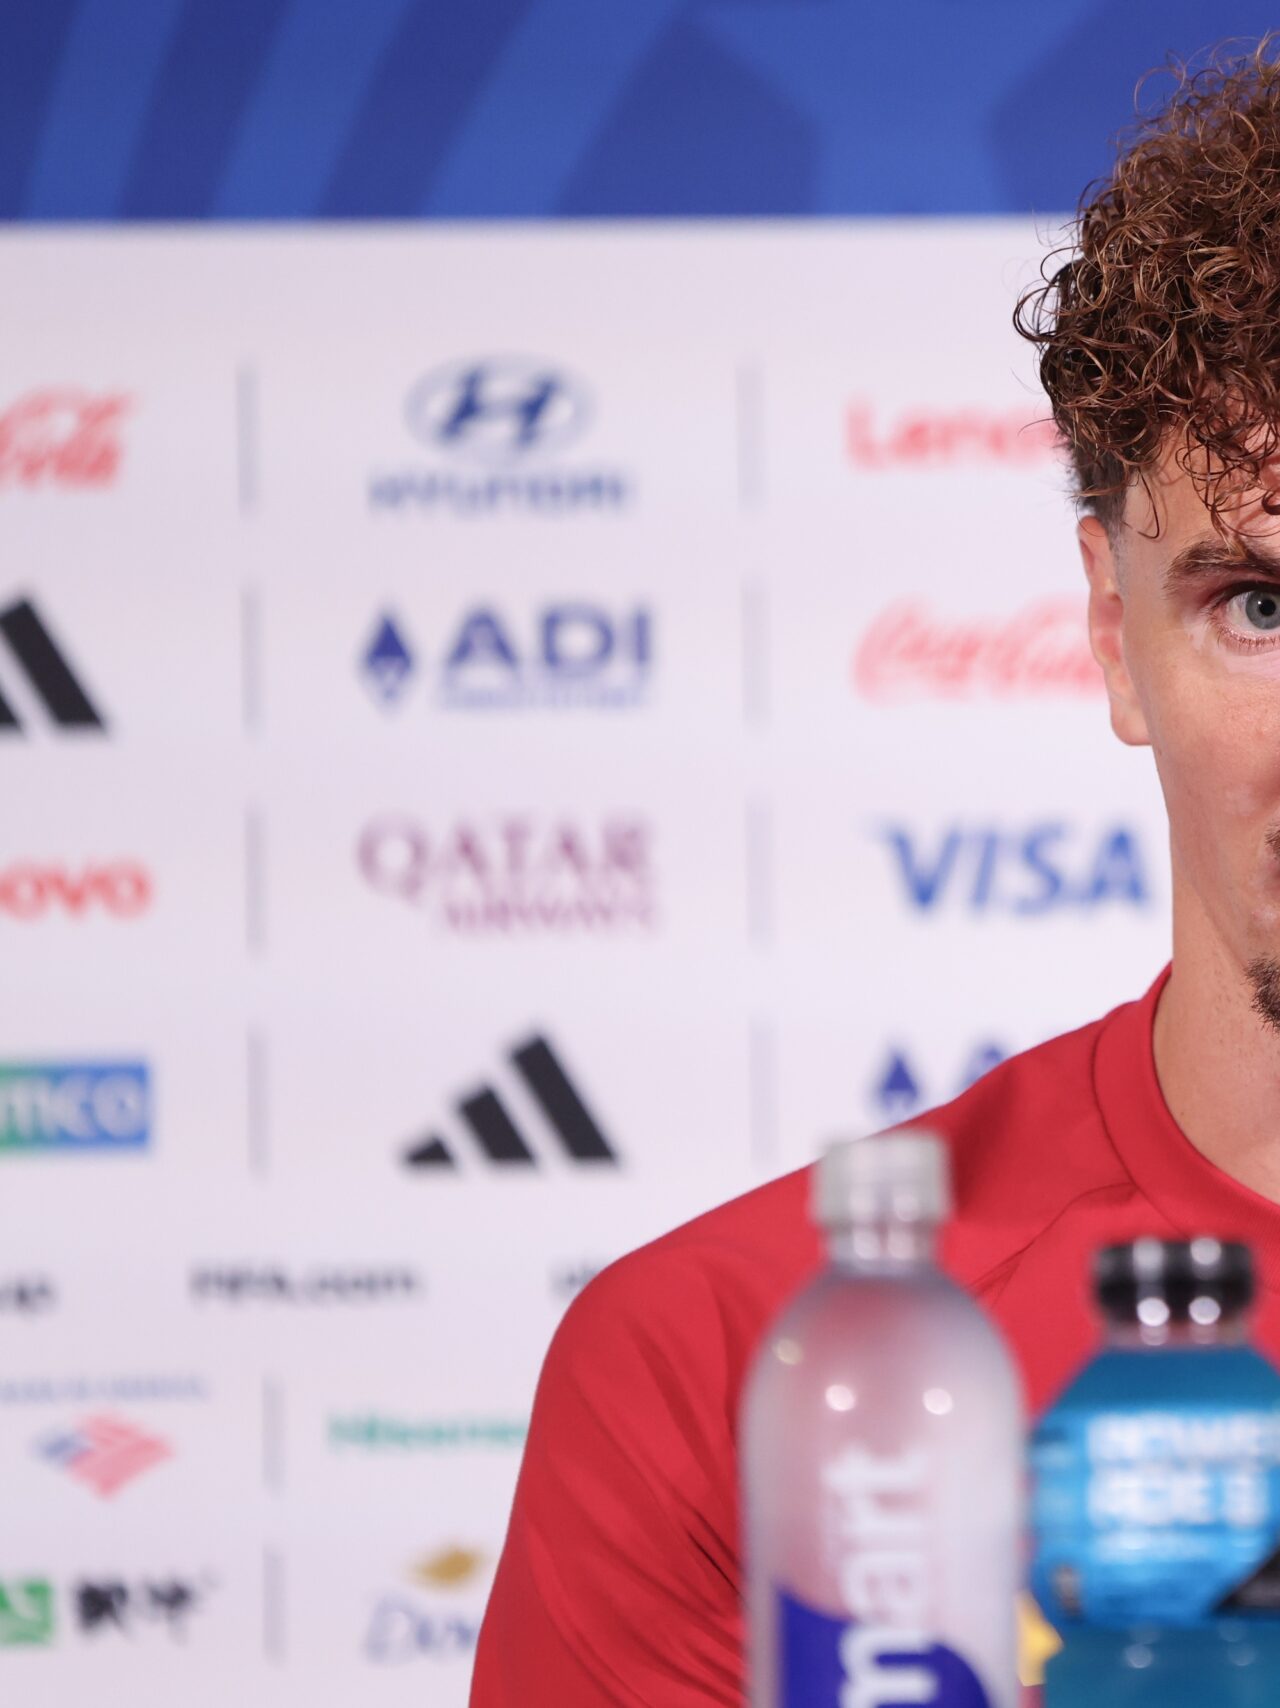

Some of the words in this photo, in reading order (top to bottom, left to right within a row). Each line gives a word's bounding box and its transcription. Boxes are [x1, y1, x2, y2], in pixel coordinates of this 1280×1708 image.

[443, 604, 654, 676] ADI
[358, 816, 652, 900] QATAR
[878, 822, 1152, 914] VISA
